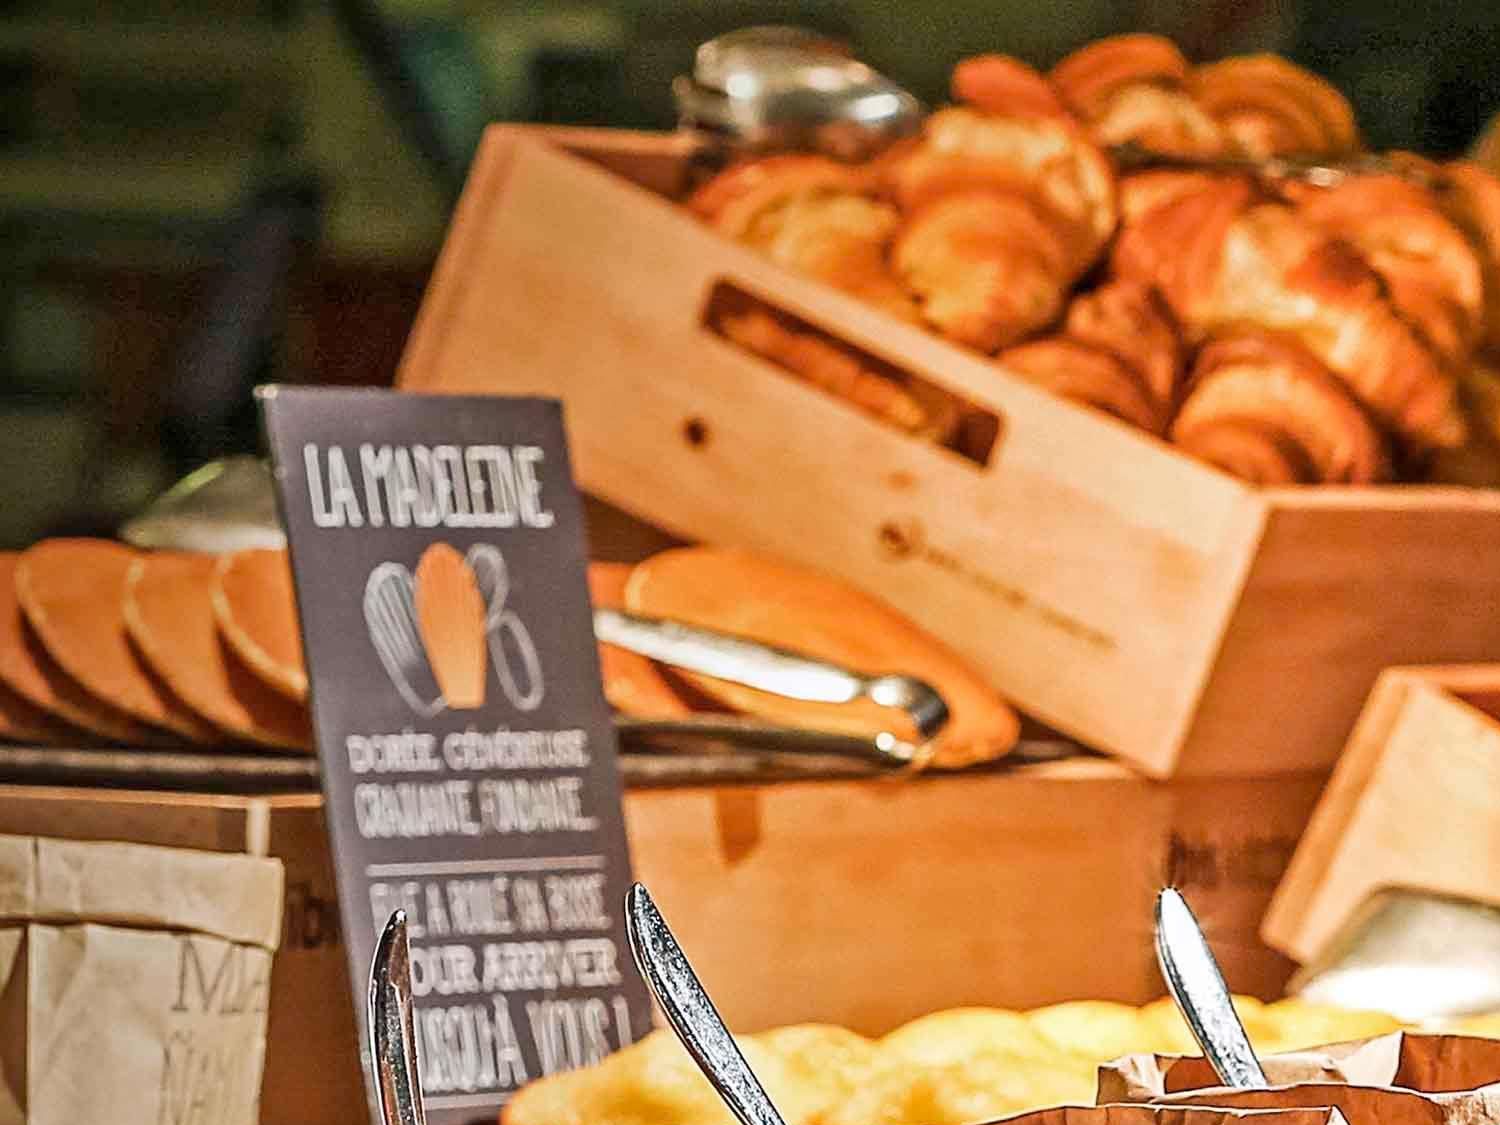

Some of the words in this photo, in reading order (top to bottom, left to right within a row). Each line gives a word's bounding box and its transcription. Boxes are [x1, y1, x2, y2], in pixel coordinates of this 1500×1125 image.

[304, 443, 364, 527] LA
[360, 443, 554, 527] MADELEINE
[410, 944, 483, 997] OUR
